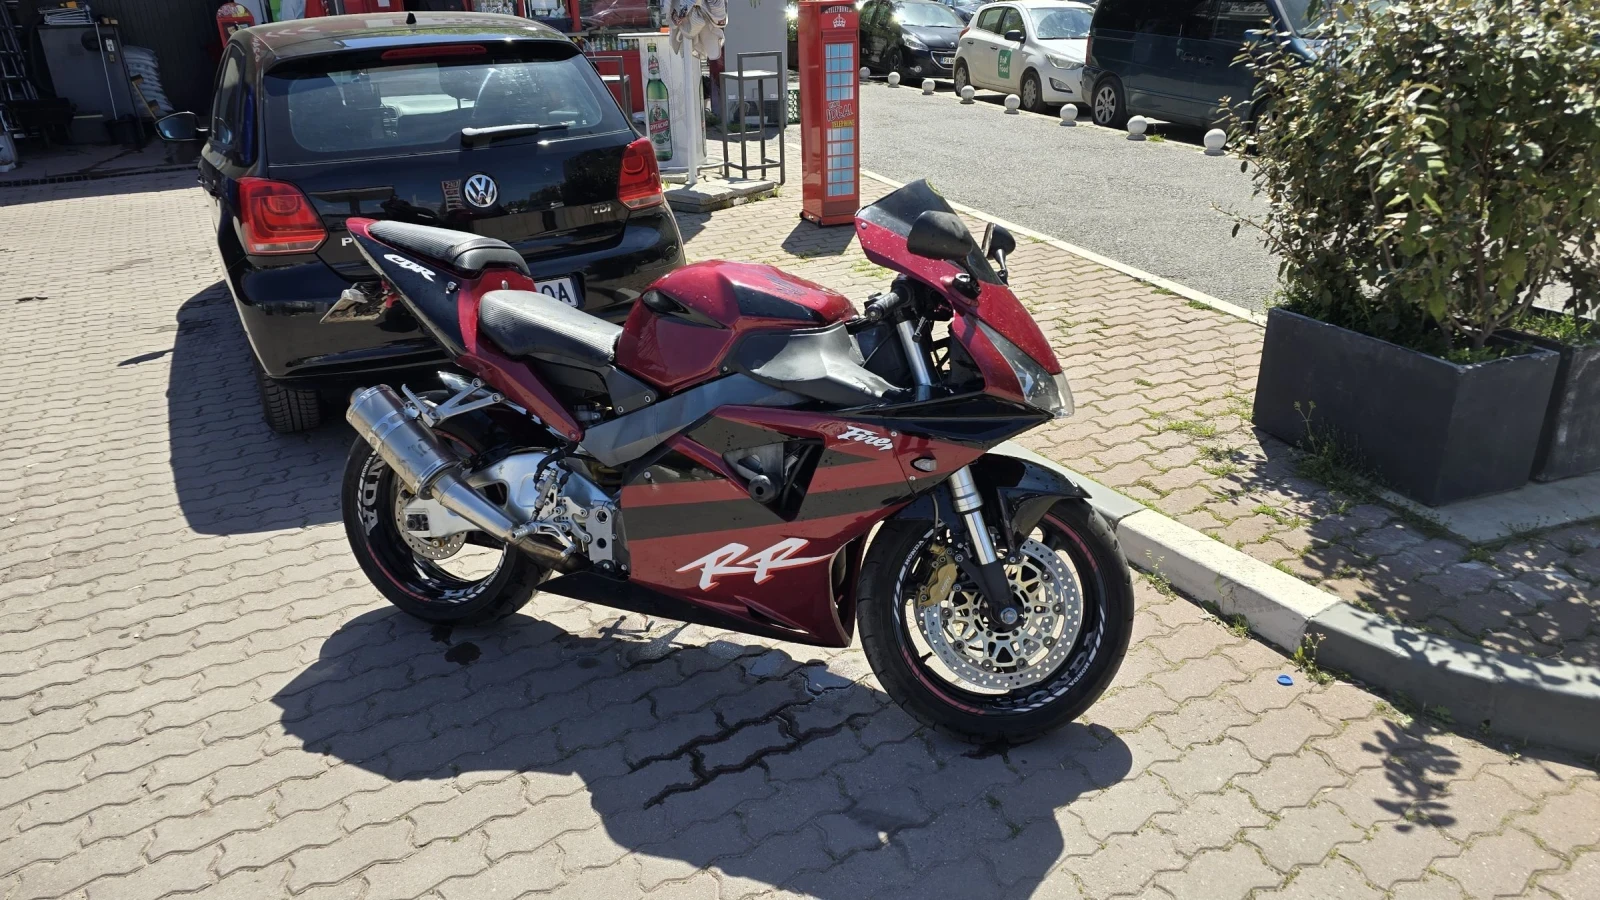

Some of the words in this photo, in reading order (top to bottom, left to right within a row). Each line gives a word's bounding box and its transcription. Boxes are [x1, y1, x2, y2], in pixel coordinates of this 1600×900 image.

[999, 64, 1008, 73] Food
[832, 119, 855, 128] TELEPHONE
[592, 203, 611, 214] TDI
[384, 254, 436, 282] CBR
[361, 456, 373, 477] HONDA
[676, 537, 834, 591] RR
[905, 541, 924, 566] HONDA
[1068, 662, 1090, 686] HONDA
